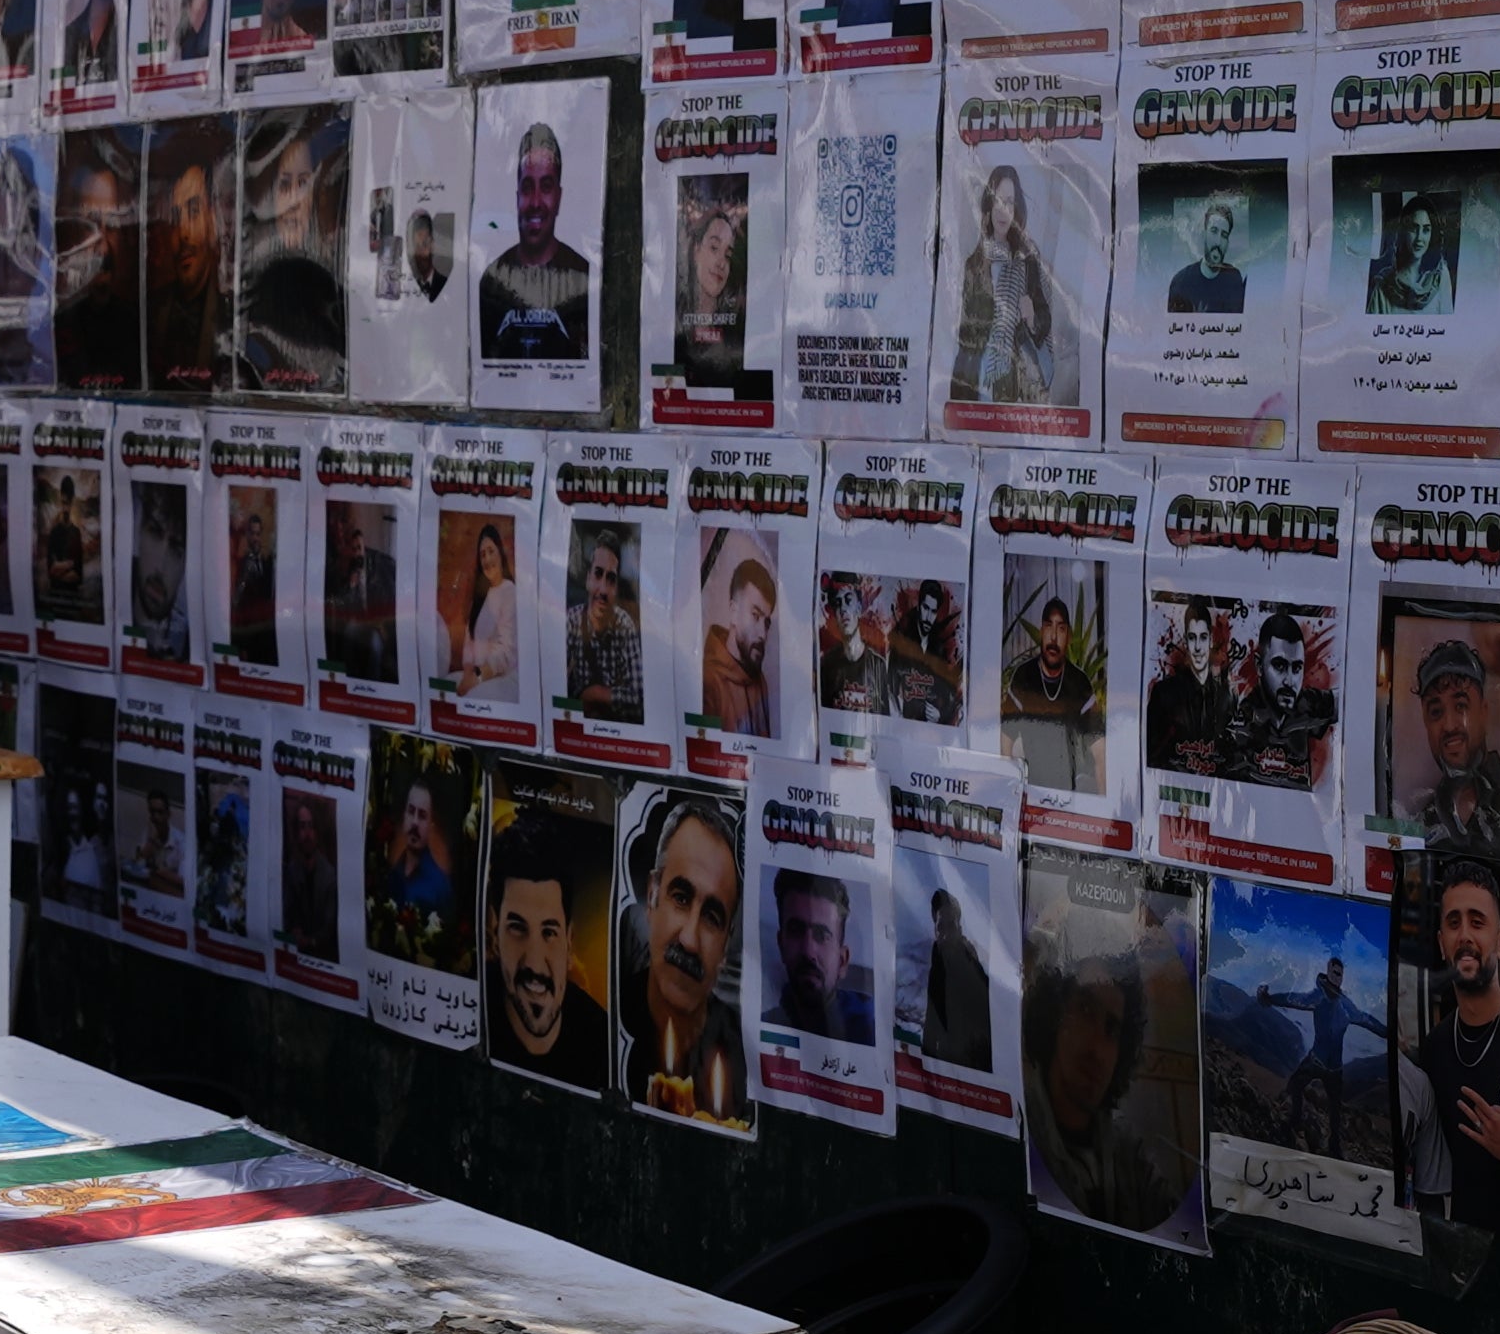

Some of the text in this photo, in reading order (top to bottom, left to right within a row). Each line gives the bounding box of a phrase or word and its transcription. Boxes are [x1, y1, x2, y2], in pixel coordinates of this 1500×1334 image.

[507, 9, 580, 31] FREE IRAN
[797, 335, 909, 352] DOCUMENTS SHOW MORE THAN
[821, 353, 847, 367] PEOPLE
[848, 354, 869, 368] WERE
[870, 354, 896, 369] KILLED
[899, 354, 908, 369] IN
[820, 370, 859, 385] DEADLIEST
[860, 372, 901, 386] MASSACRE
[818, 387, 852, 402] BETWEEN
[853, 389, 885, 403] JANUARY
[886, 389, 901, 403] 8-9
[1075, 882, 1127, 905] KAZEROON
[367, 969, 478, 1010] جاوید نام ایوب
[382, 998, 478, 1040] شریفی کازرون
